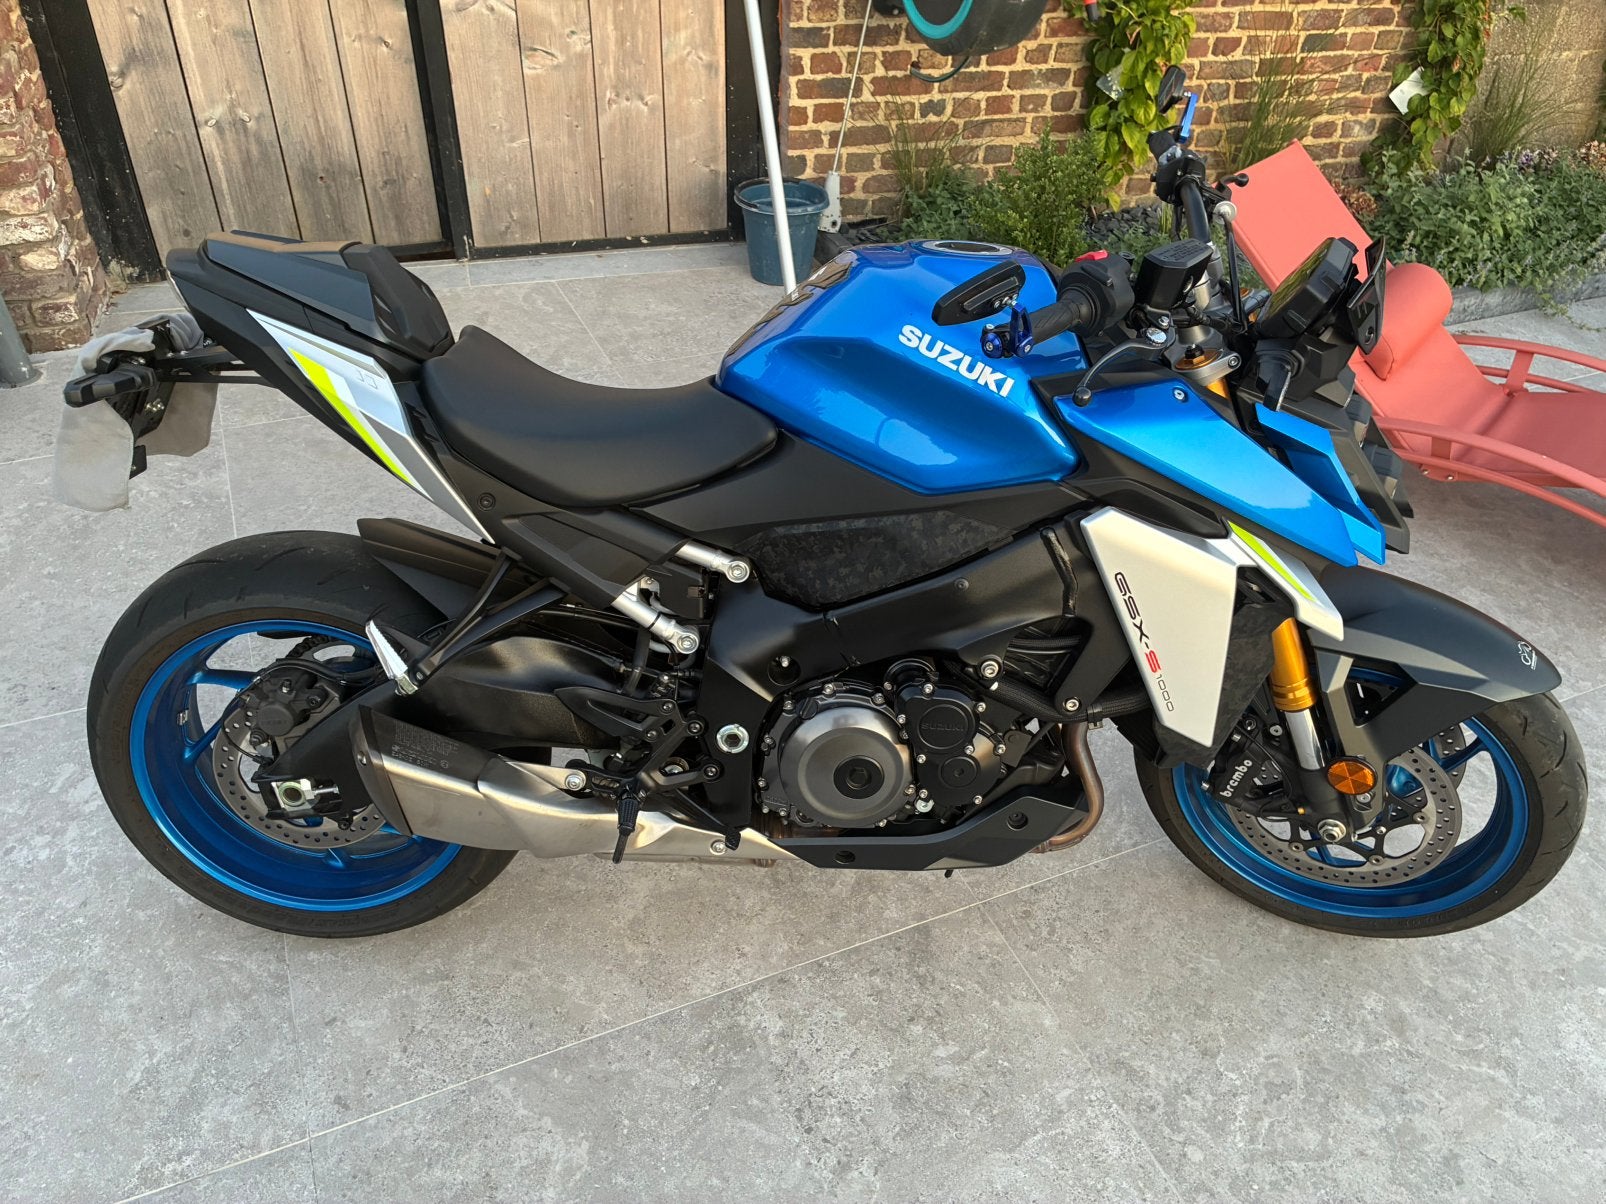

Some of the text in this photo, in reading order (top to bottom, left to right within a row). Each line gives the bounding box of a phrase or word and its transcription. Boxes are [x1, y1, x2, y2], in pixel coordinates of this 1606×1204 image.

[898, 324, 1015, 398] SUZUKI
[921, 721, 965, 732] SUZUKI
[1219, 759, 1253, 798] brembo
